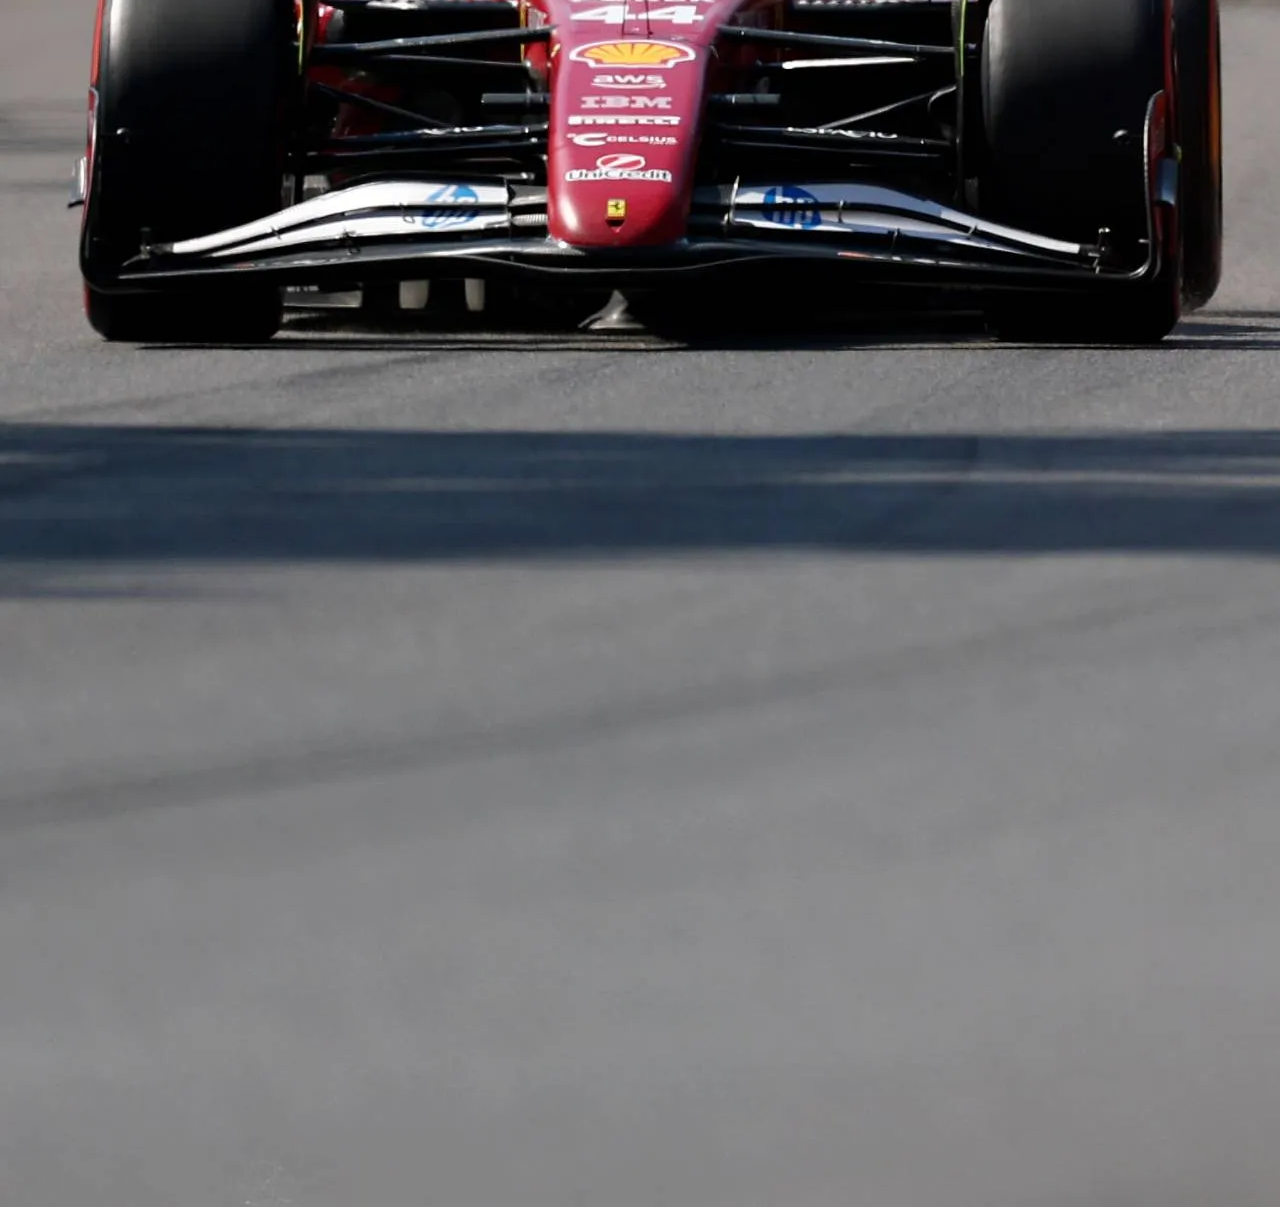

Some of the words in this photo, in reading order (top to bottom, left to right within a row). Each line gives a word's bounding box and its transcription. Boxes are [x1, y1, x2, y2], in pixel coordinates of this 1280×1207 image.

[570, 5, 704, 24] 44
[592, 74, 666, 85] aws
[581, 96, 672, 109] IBM
[566, 169, 672, 182] UniCredit
